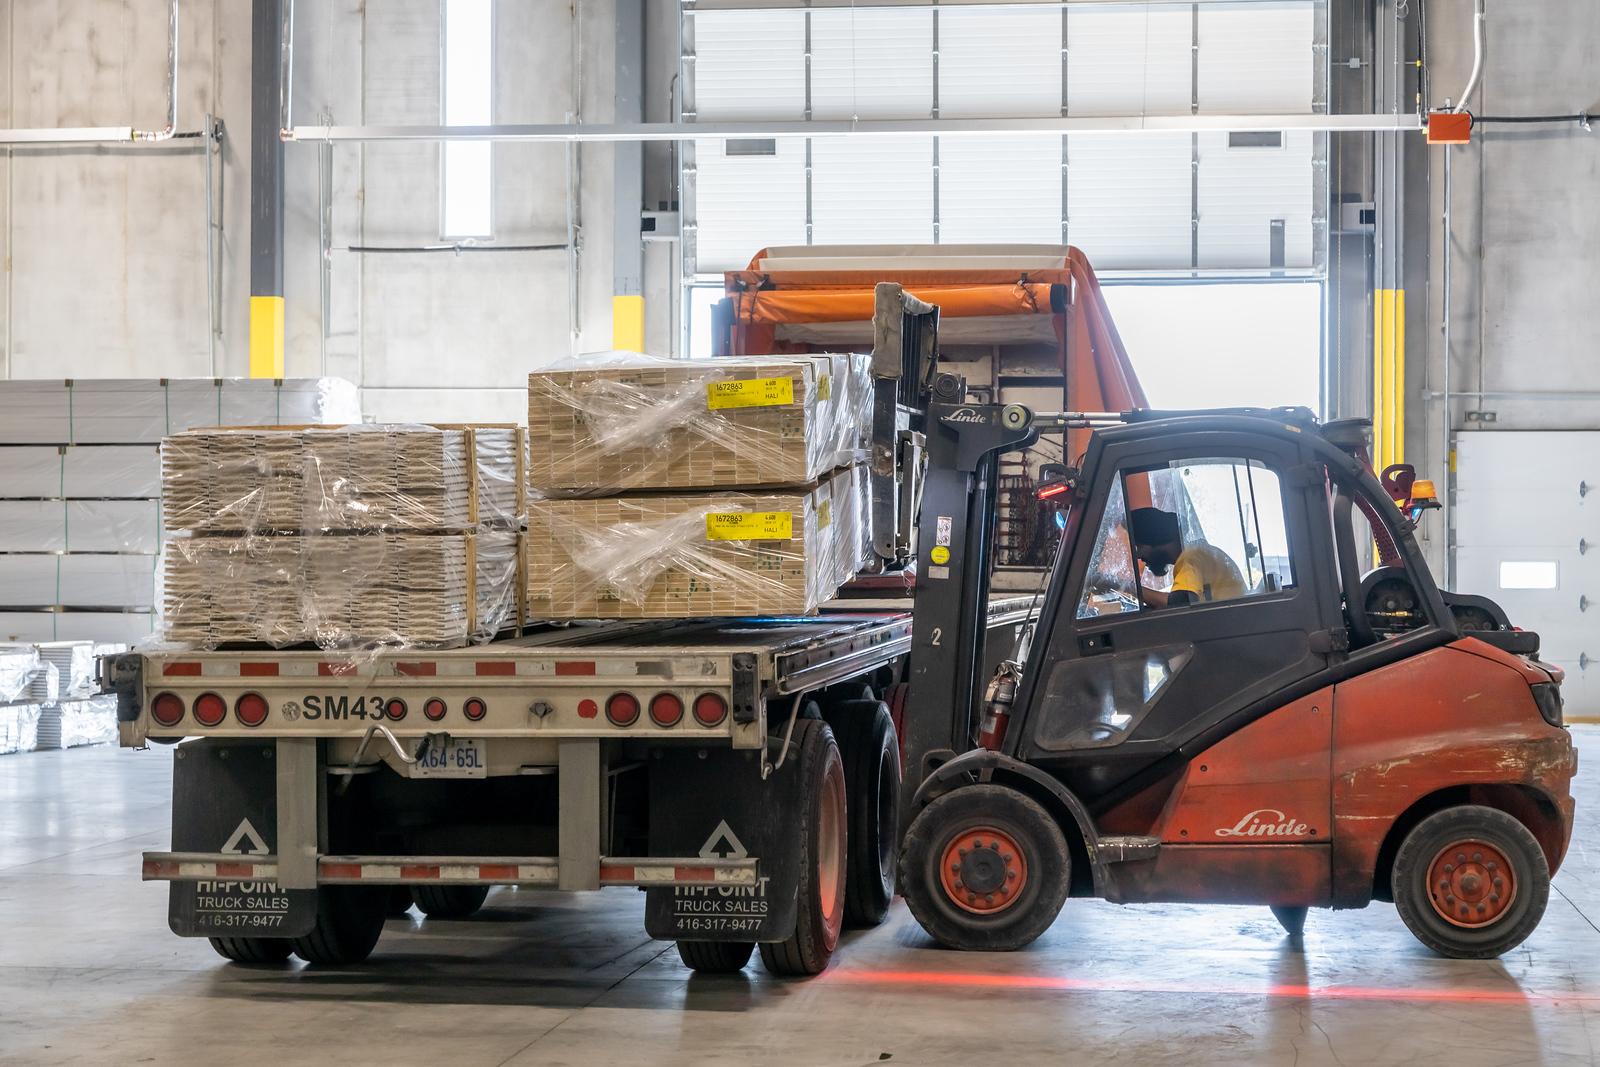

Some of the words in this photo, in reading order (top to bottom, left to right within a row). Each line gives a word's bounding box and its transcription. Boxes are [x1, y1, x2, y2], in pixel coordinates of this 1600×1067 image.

[716, 382, 743, 391] 1672863
[940, 408, 986, 423] Linde
[715, 514, 743, 522] 1672863
[931, 627, 942, 646] 2
[302, 695, 385, 721] SM43
[456, 748, 483, 768] 65L
[1215, 809, 1308, 837] Linde
[196, 880, 286, 894] HI-POIN
[197, 896, 243, 908] TRUCK
[246, 897, 289, 909] SALES
[675, 900, 721, 912] TRUCK
[725, 901, 769, 913] SALES
[199, 915, 283, 927] 416-317-9477
[676, 918, 762, 930] 416-317-9477
